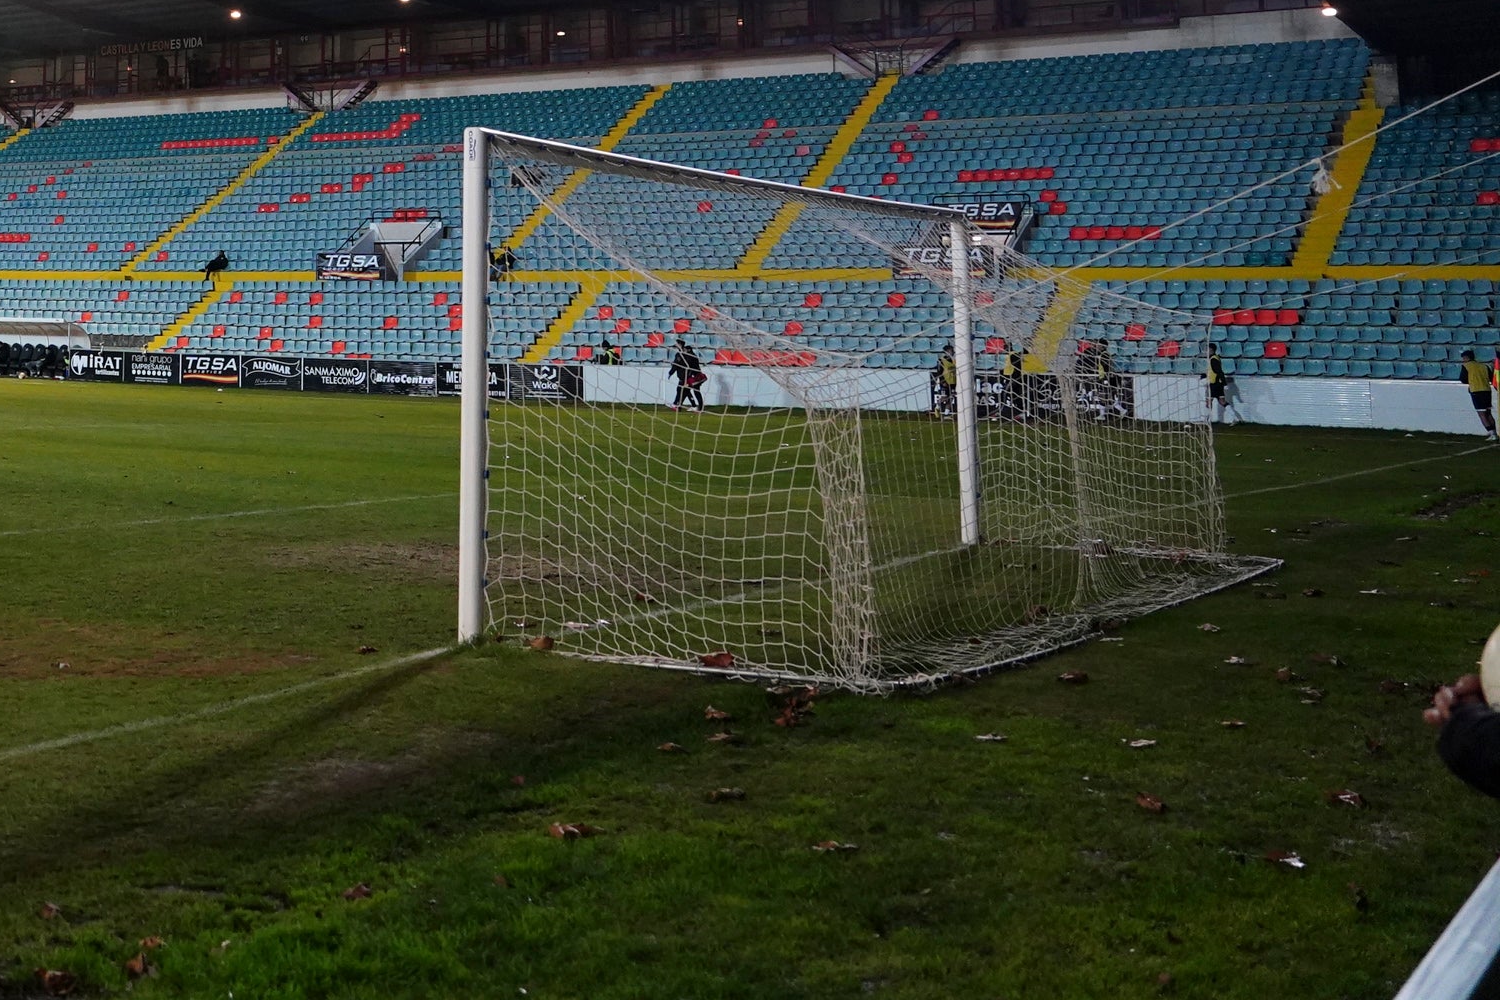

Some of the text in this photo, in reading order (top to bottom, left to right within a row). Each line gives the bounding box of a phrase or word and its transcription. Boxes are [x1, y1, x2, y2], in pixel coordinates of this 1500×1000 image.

[101, 43, 139, 56] CASTILLA
[170, 39, 181, 50] ES
[183, 37, 203, 49] VIDA
[325, 255, 379, 268] TGSA
[149, 356, 172, 365] grupo
[185, 357, 237, 371] TGSA
[132, 363, 173, 372] EMPRESARIAL
[252, 360, 291, 376] ALJOMAR
[321, 376, 355, 385] TELECOM
[375, 372, 435, 385] BricoCentro
[532, 379, 559, 390] Wake
